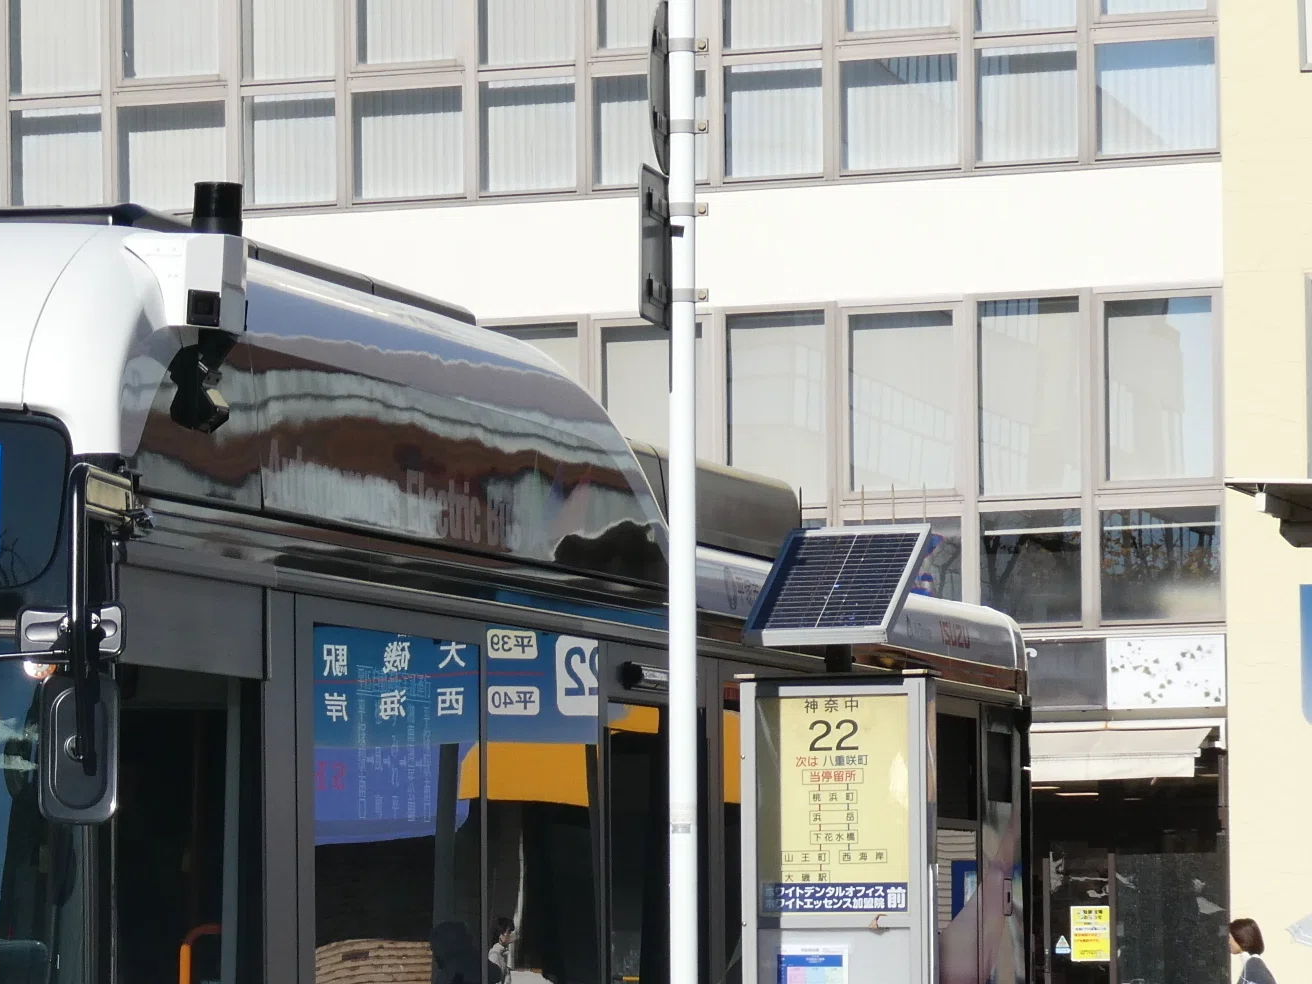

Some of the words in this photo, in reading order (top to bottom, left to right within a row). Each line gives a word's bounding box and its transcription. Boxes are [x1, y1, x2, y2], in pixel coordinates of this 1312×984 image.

[940, 620, 971, 649] ISUZU
[804, 699, 859, 713] 神奈中
[808, 719, 859, 751] 22
[796, 755, 819, 767] 次は
[809, 770, 856, 782] 当停留所
[784, 852, 826, 863] 山王町
[842, 851, 884, 862] 西海岸
[784, 873, 827, 883] 大磯駅
[887, 887, 906, 909] 前
